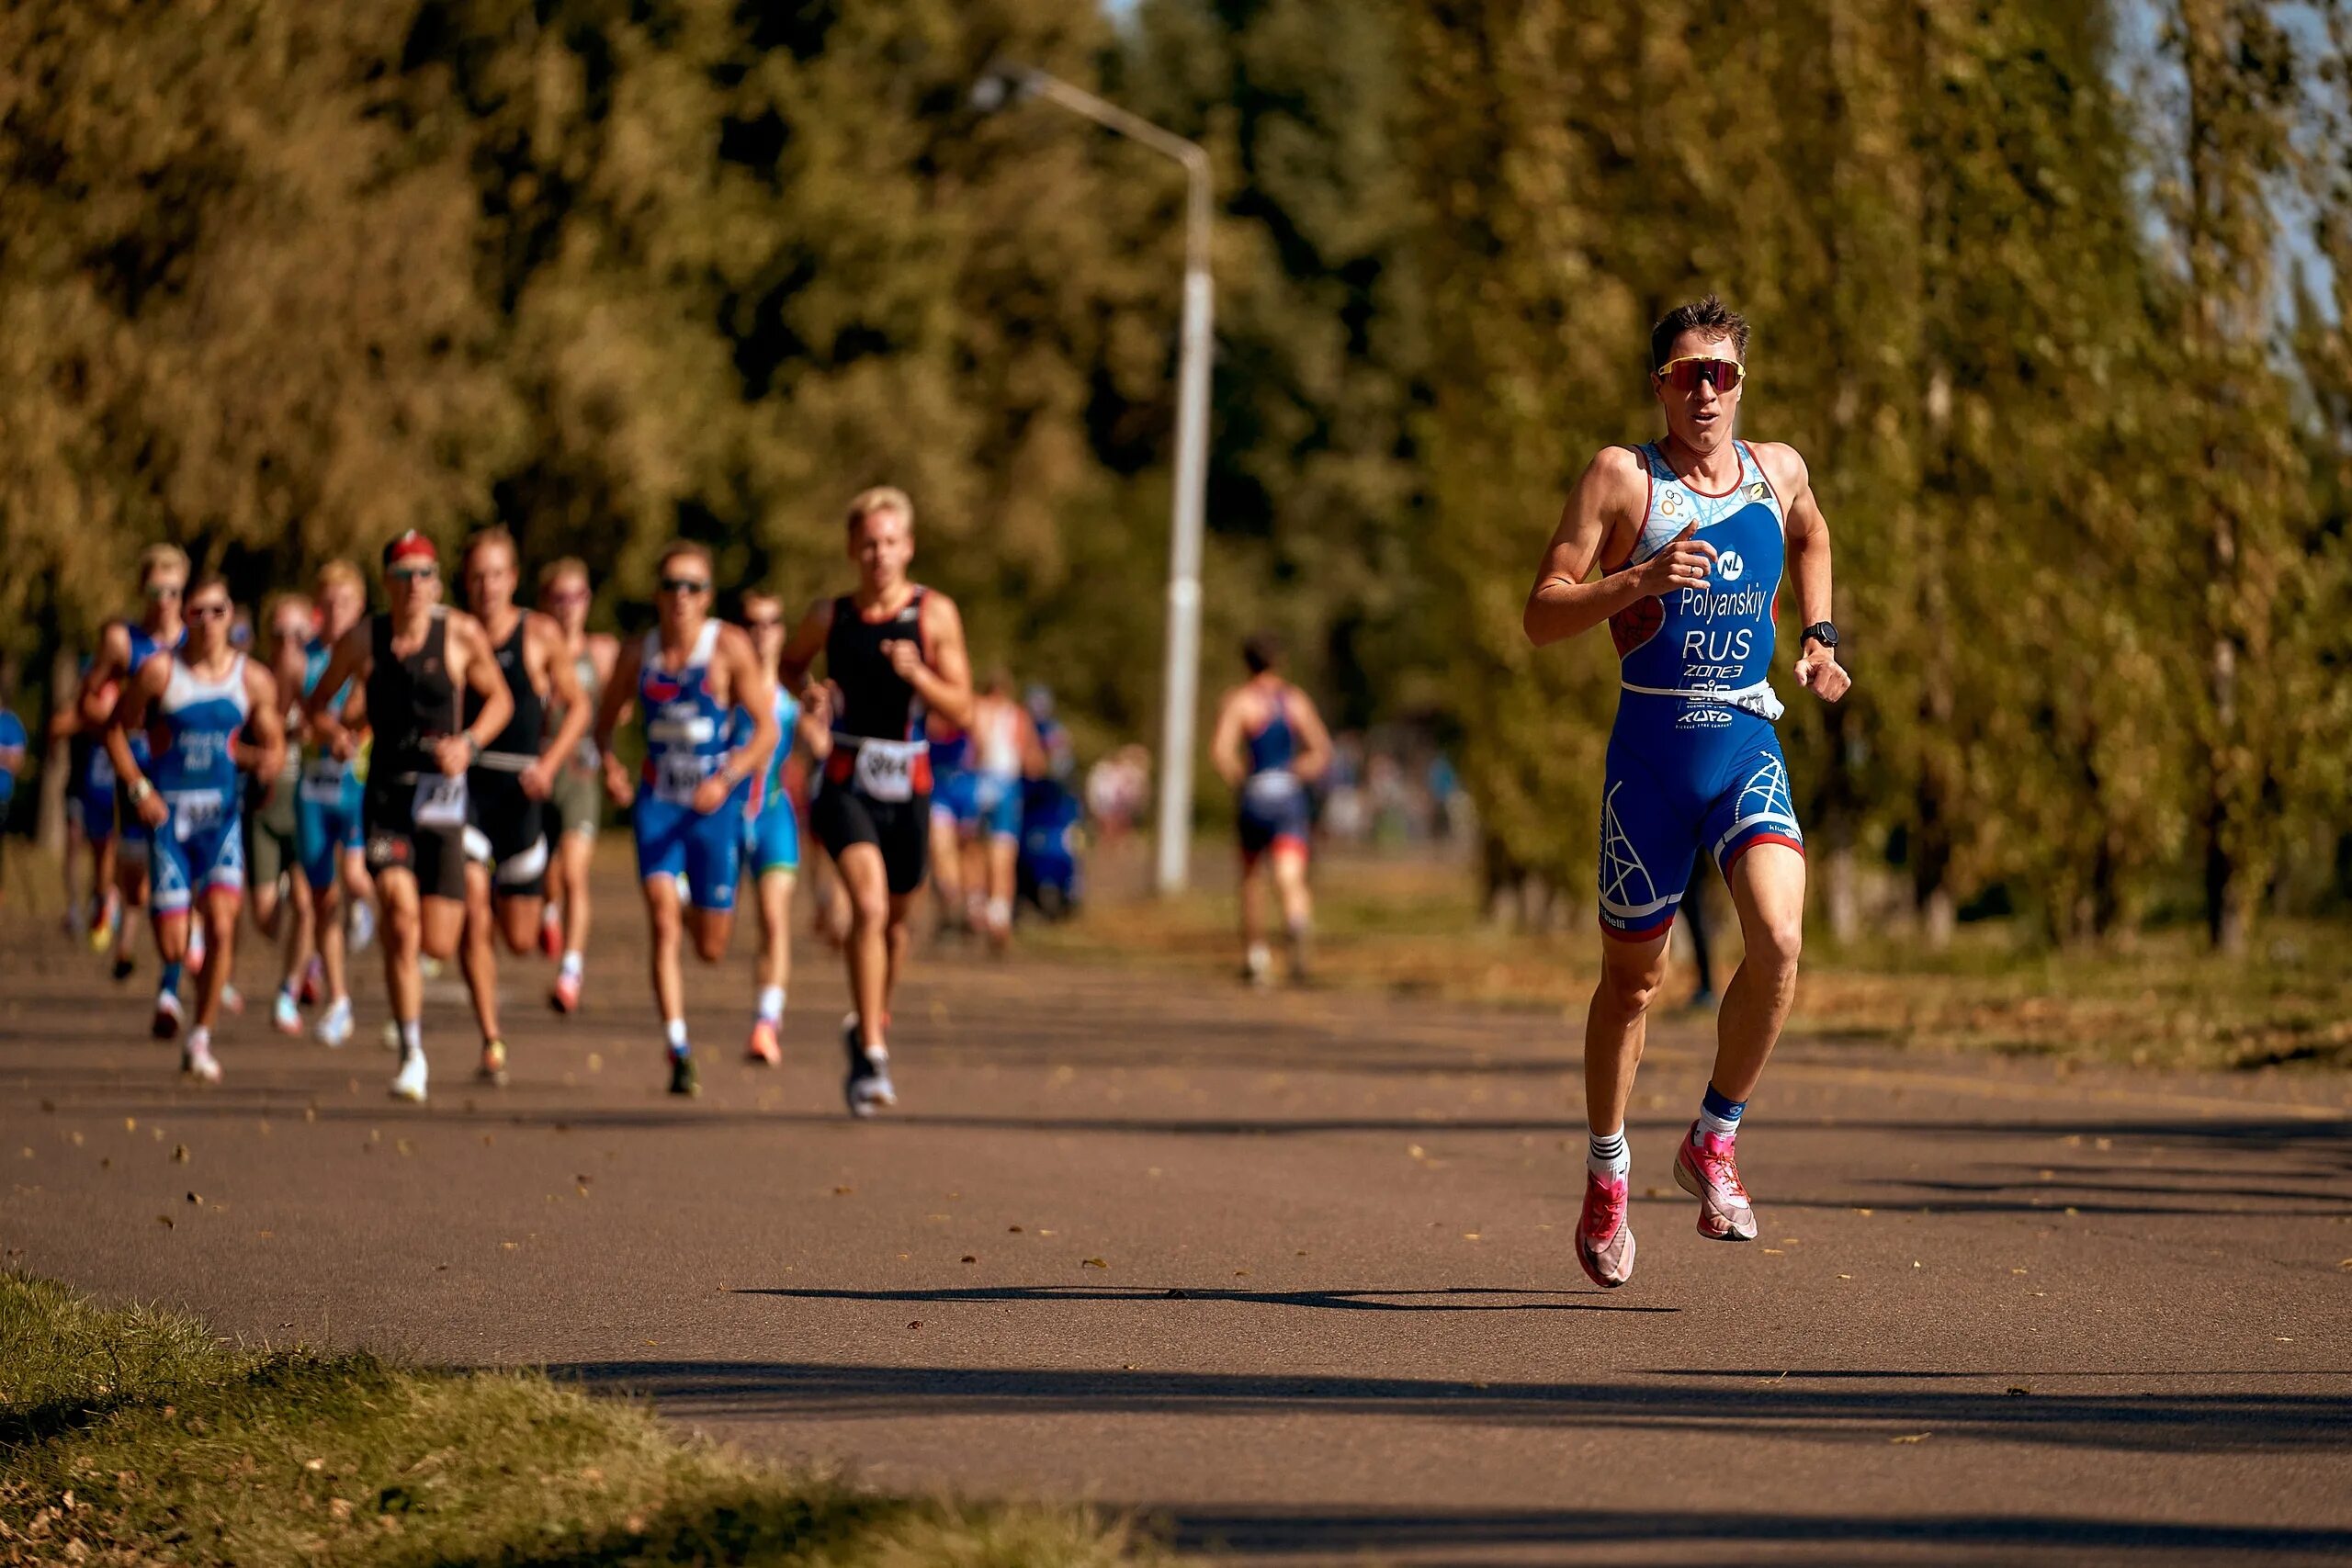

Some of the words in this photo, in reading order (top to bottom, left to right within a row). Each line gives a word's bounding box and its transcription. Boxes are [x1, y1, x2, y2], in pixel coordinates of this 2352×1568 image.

[1721, 553, 1739, 577] NL
[1679, 582, 1767, 625] Polyanskiy
[1682, 628, 1753, 661] RUS
[1678, 709, 1733, 723] TUFO
